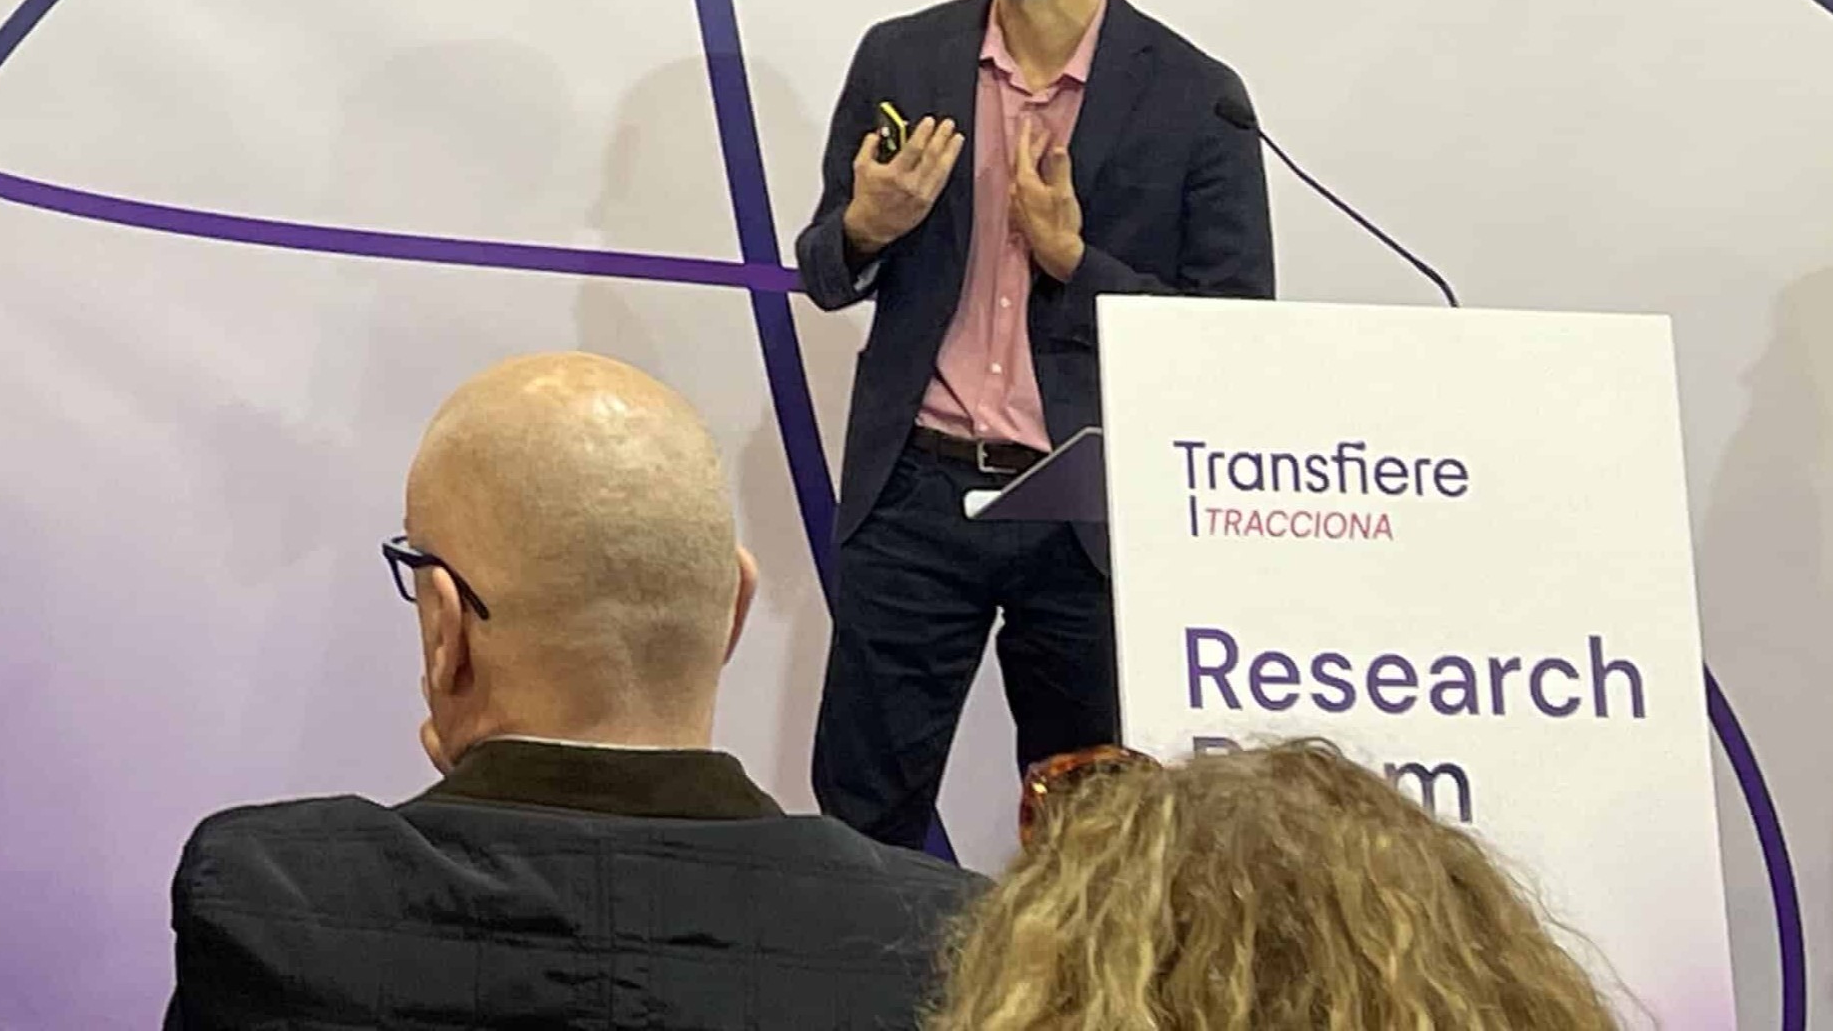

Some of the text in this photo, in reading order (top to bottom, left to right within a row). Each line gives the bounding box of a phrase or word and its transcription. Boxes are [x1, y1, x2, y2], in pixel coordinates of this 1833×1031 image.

[1173, 440, 1469, 498] Transfiere
[1206, 508, 1394, 540] TRACCIONA
[1185, 627, 1647, 719] Research
